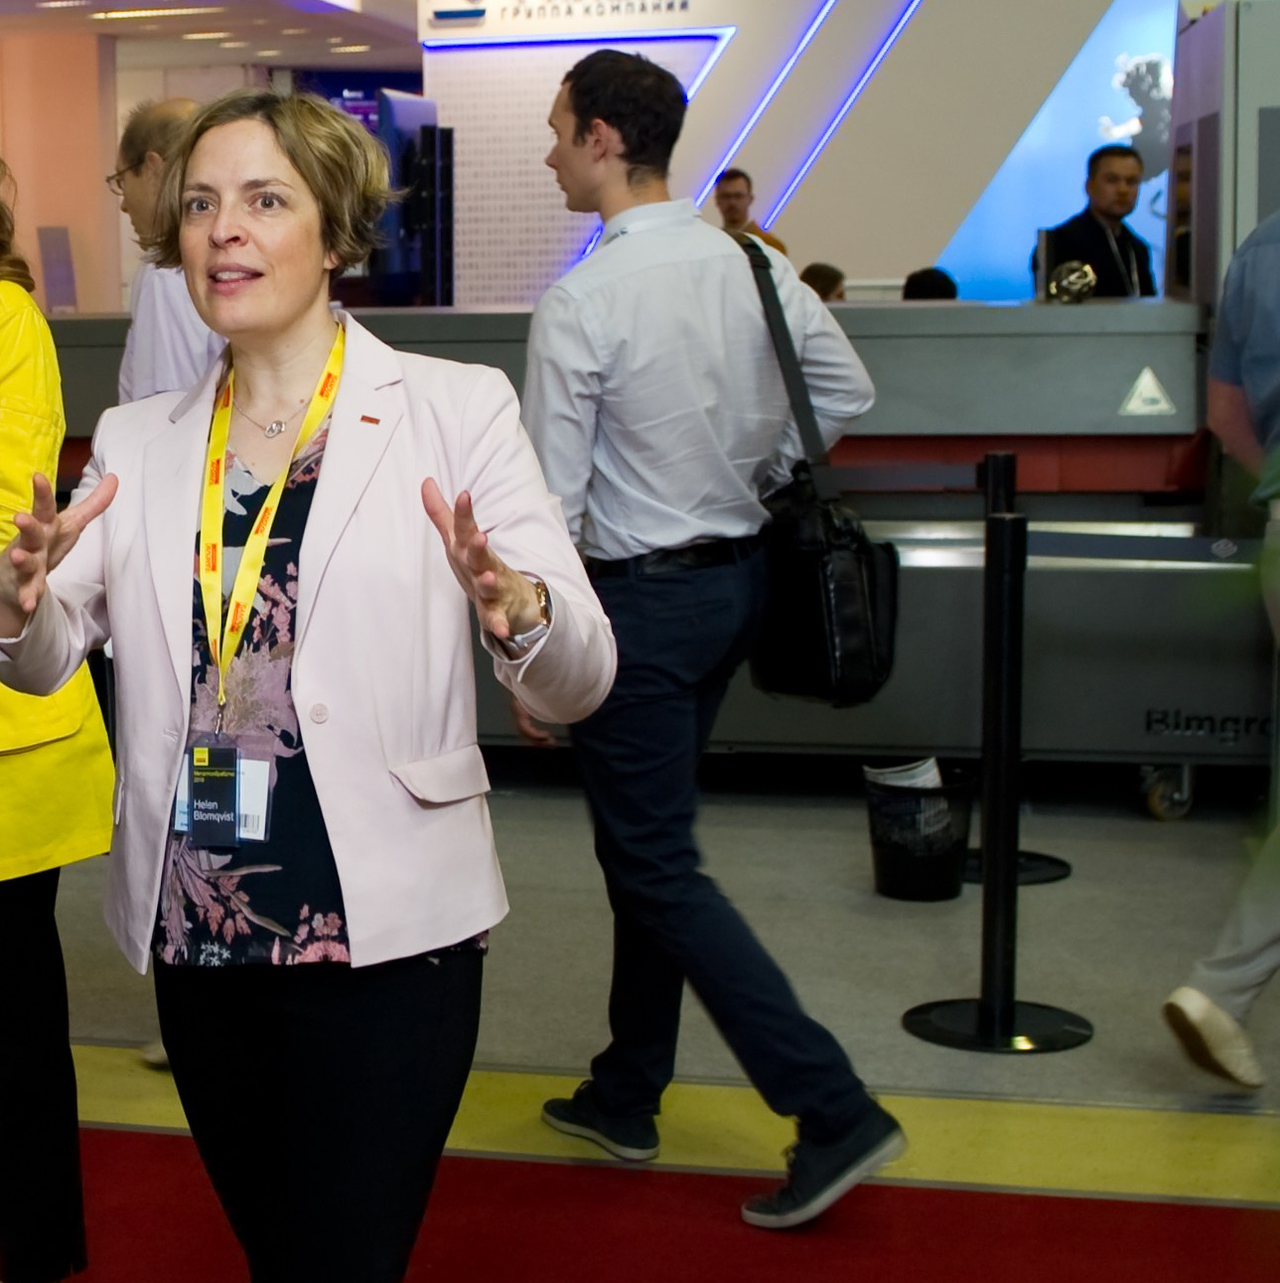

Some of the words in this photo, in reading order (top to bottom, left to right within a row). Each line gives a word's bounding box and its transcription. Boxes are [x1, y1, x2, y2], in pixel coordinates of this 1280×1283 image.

[500, 4, 574, 19] ГРУППА
[193, 799, 219, 810] Helen
[193, 810, 236, 824] Blomqvist
